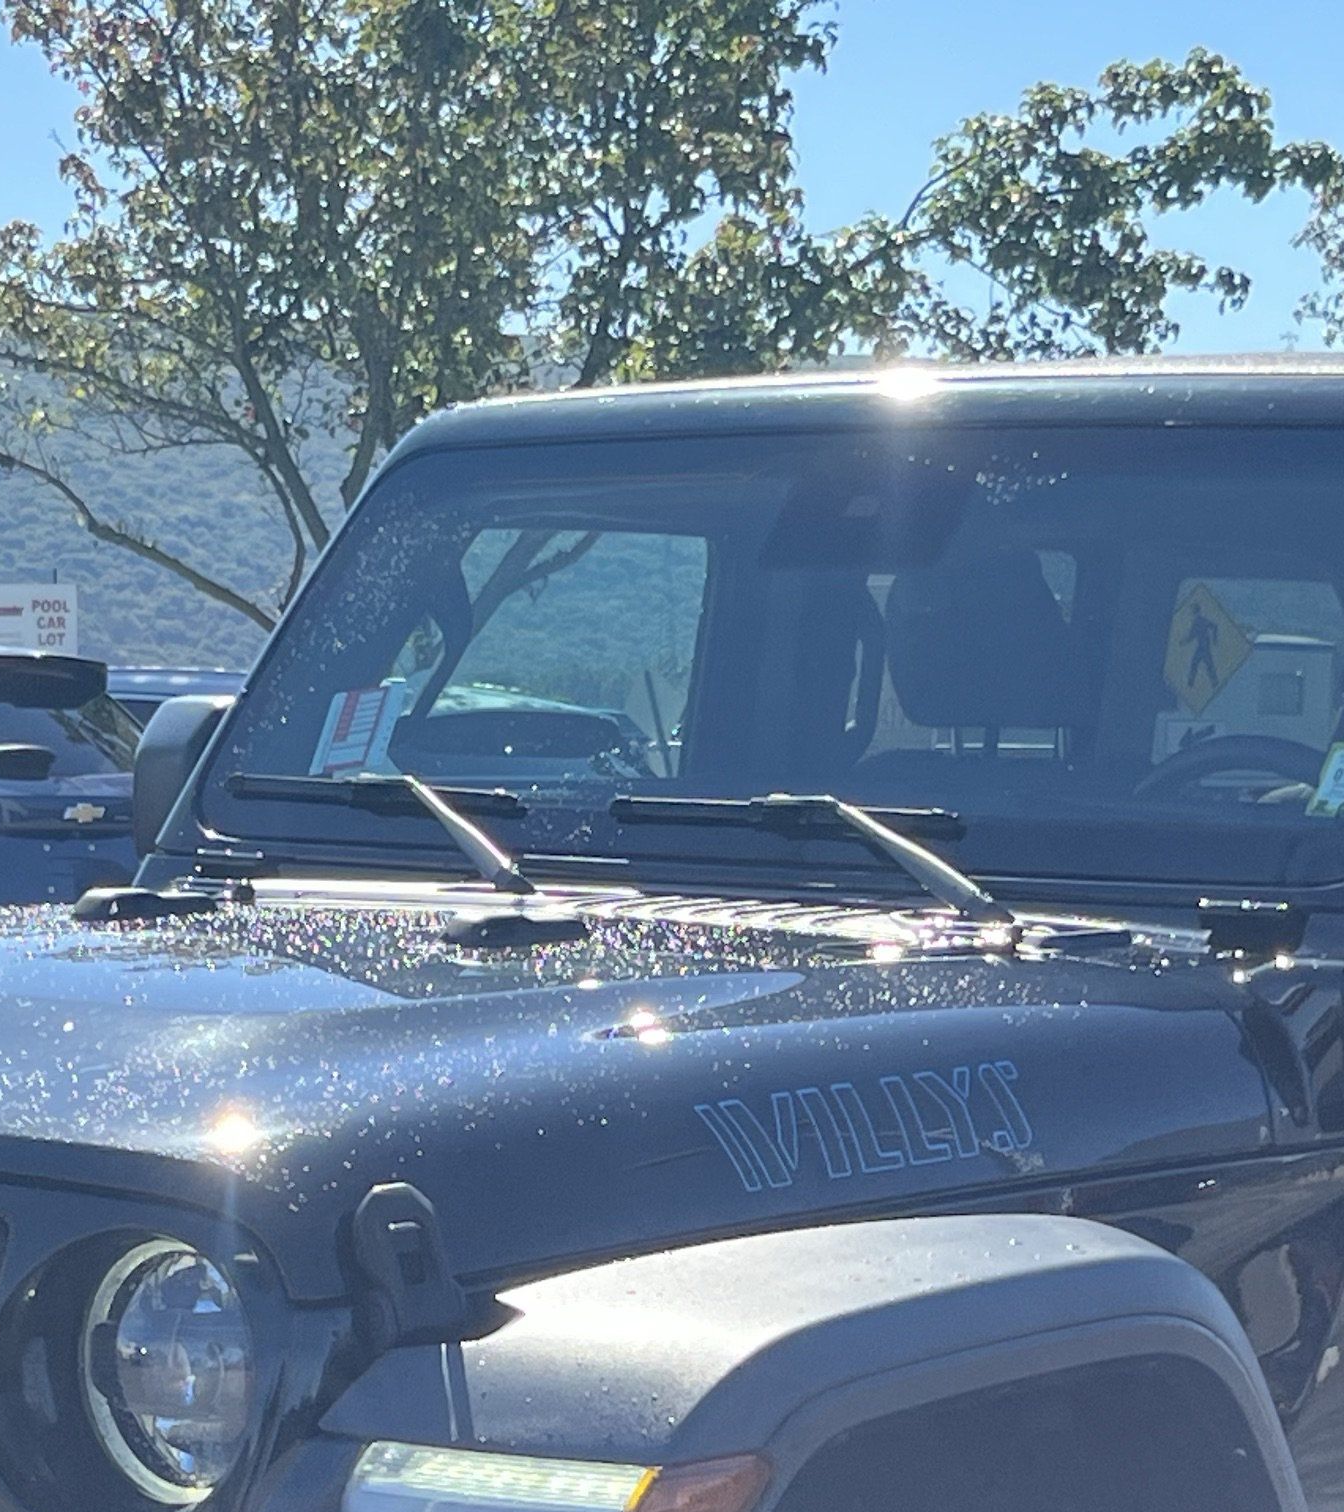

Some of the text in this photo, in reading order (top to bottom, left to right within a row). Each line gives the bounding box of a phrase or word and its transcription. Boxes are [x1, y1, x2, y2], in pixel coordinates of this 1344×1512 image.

[31, 599, 71, 613] POOL
[36, 616, 67, 630] CAR
[37, 632, 66, 646] LOT
[693, 1059, 1033, 1193] WILLYS
